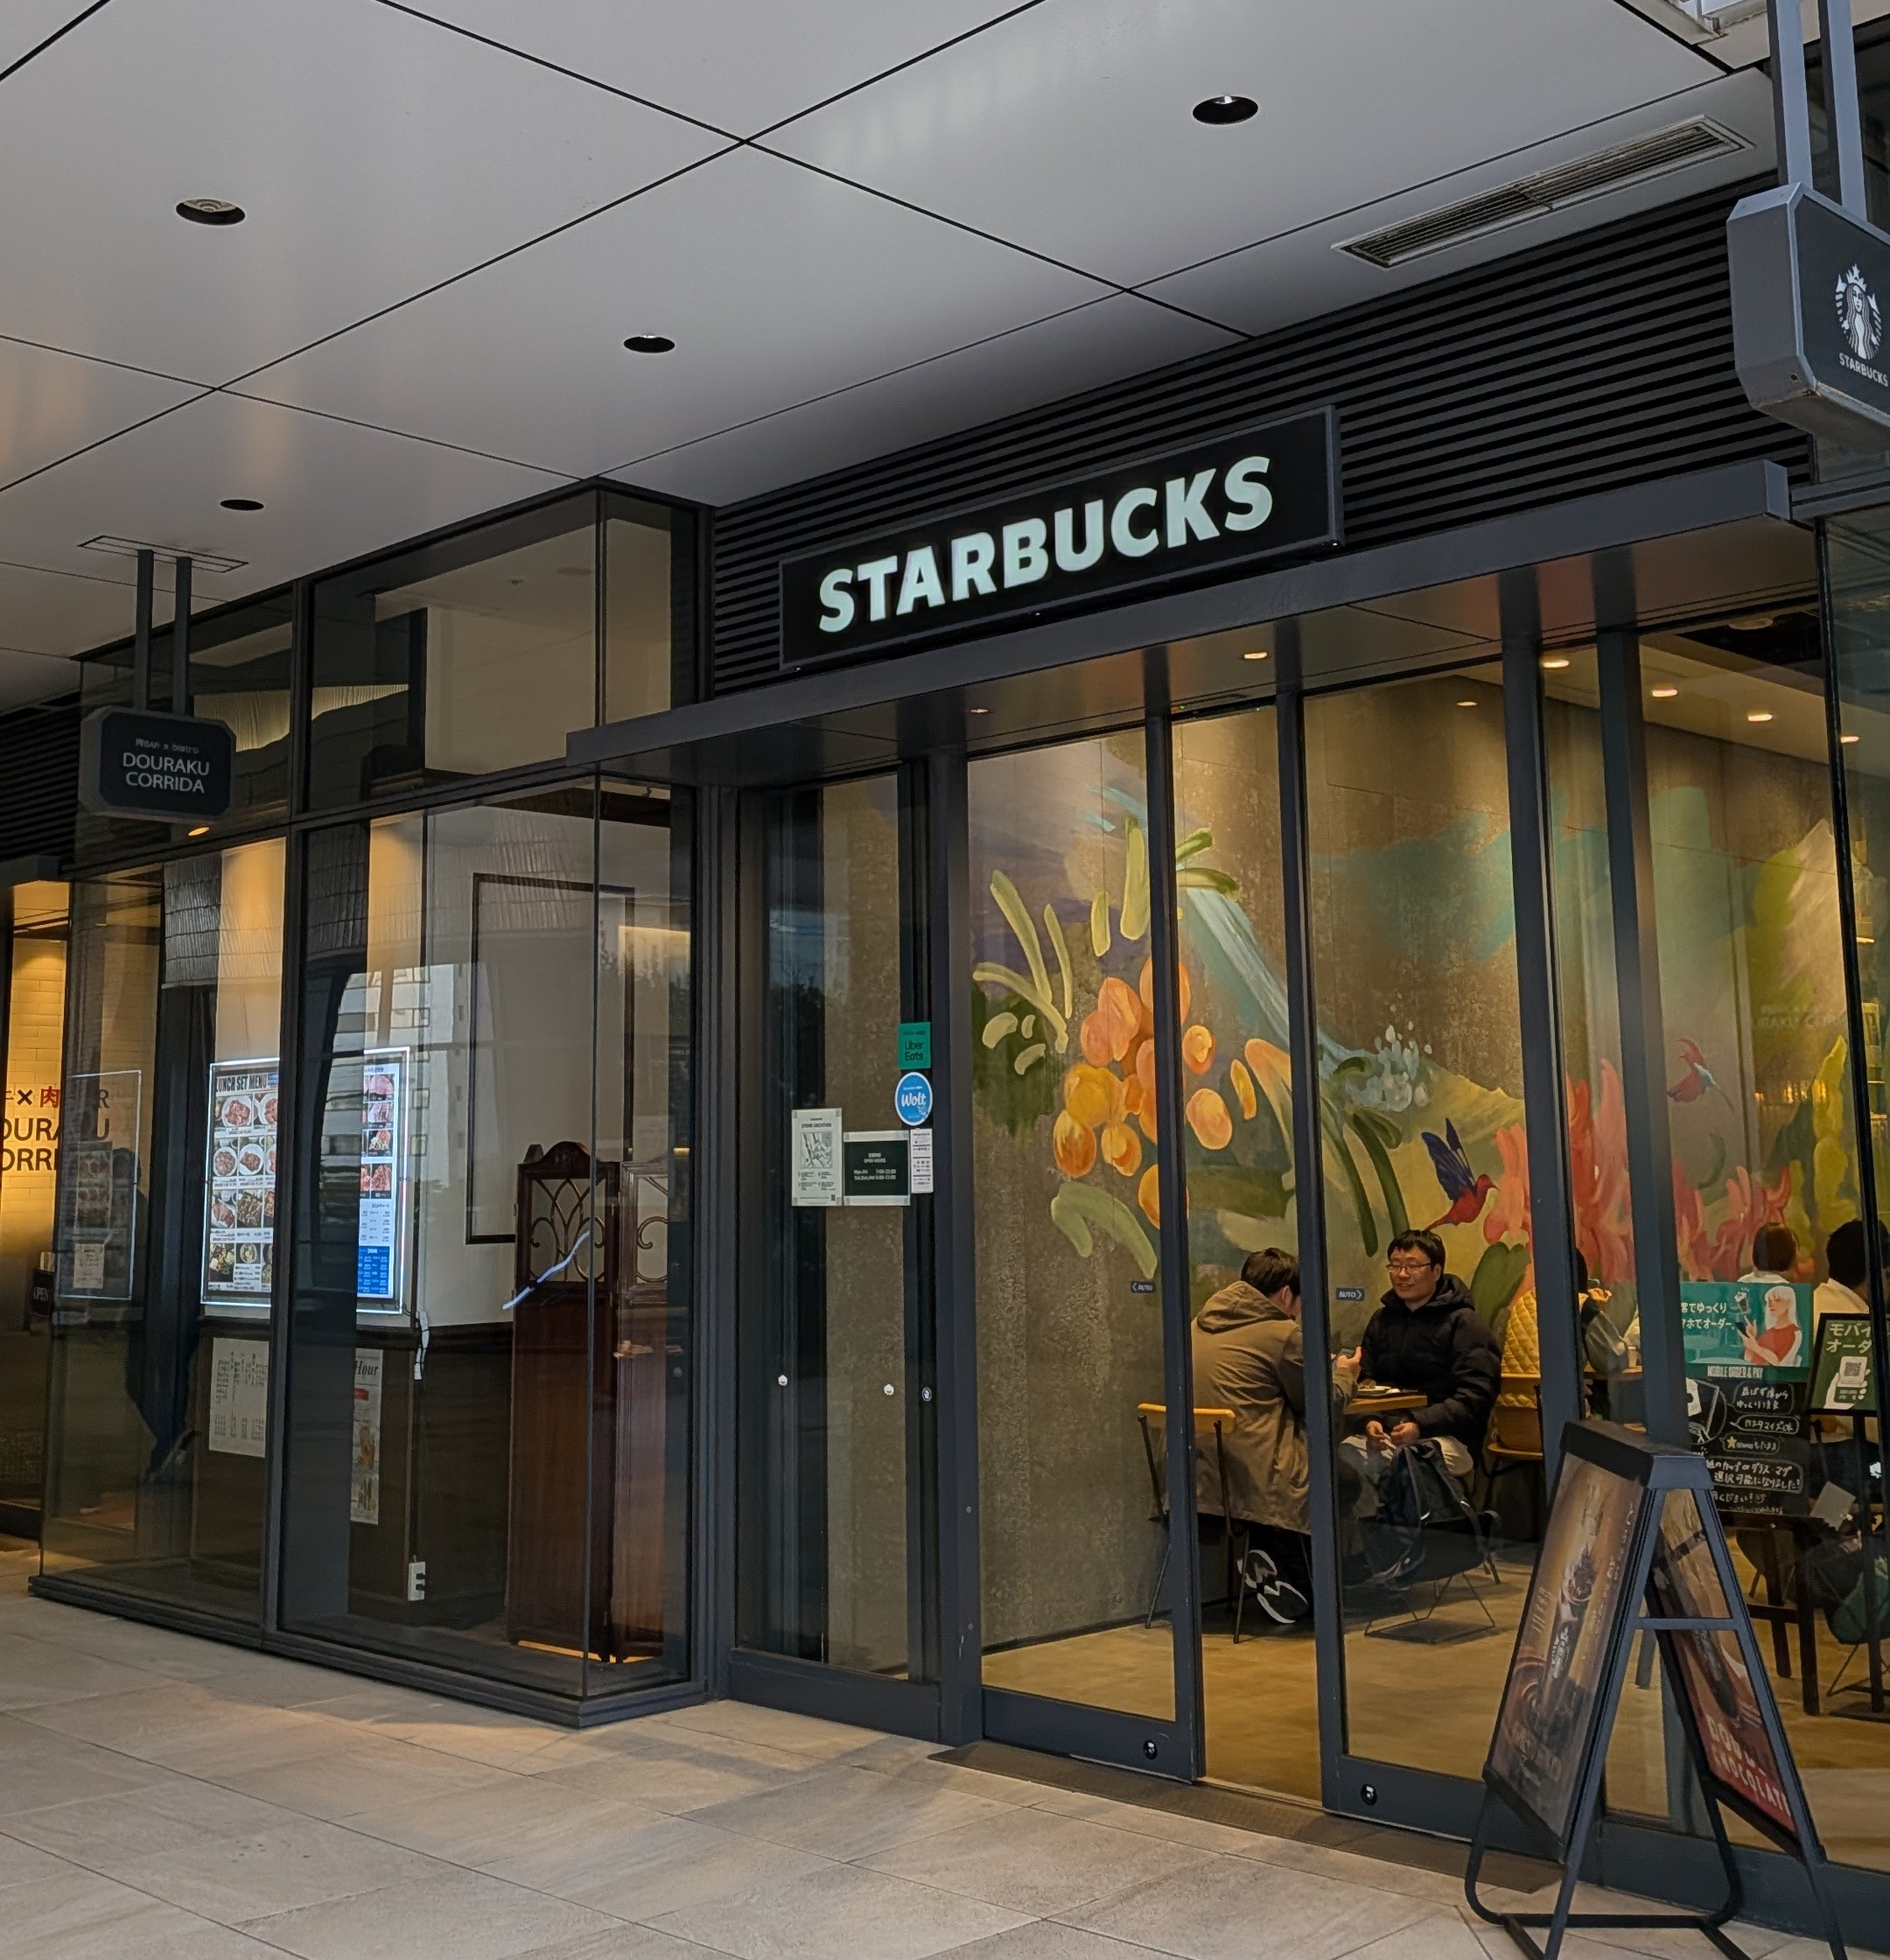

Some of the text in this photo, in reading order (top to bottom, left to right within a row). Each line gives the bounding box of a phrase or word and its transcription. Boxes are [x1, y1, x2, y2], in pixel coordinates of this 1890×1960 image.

[1839, 352, 1888, 387] STARBUCKS
[819, 455, 1273, 633] STARBUCKS
[122, 752, 210, 776] DOURAKU
[125, 771, 205, 794] CORRIDA
[905, 1040, 924, 1051] Uber
[905, 1052, 924, 1061] Eats
[236, 1075, 248, 1091] SET
[901, 1092, 927, 1107] Wolt
[354, 1360, 379, 1376] Hour
